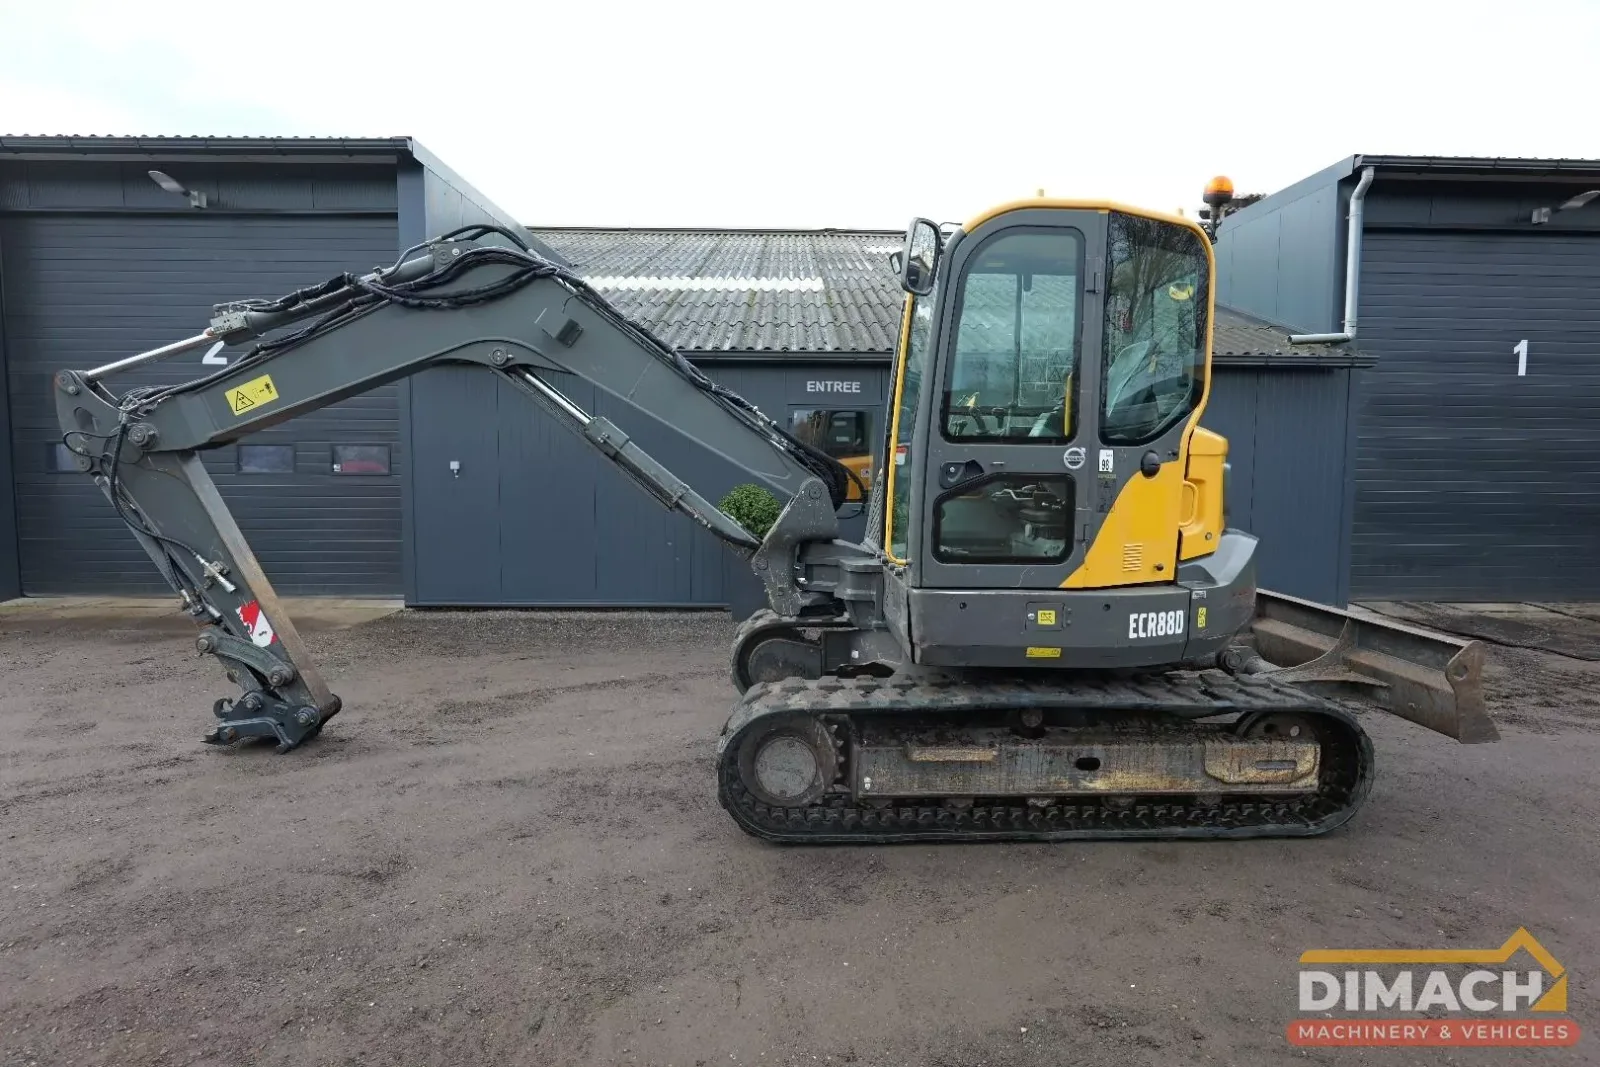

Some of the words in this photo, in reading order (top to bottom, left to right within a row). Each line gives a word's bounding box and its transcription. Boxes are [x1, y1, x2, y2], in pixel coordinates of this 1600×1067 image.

[1513, 339, 1529, 376] 1
[806, 380, 861, 393] ENTREE
[1128, 610, 1185, 639] ECR88D
